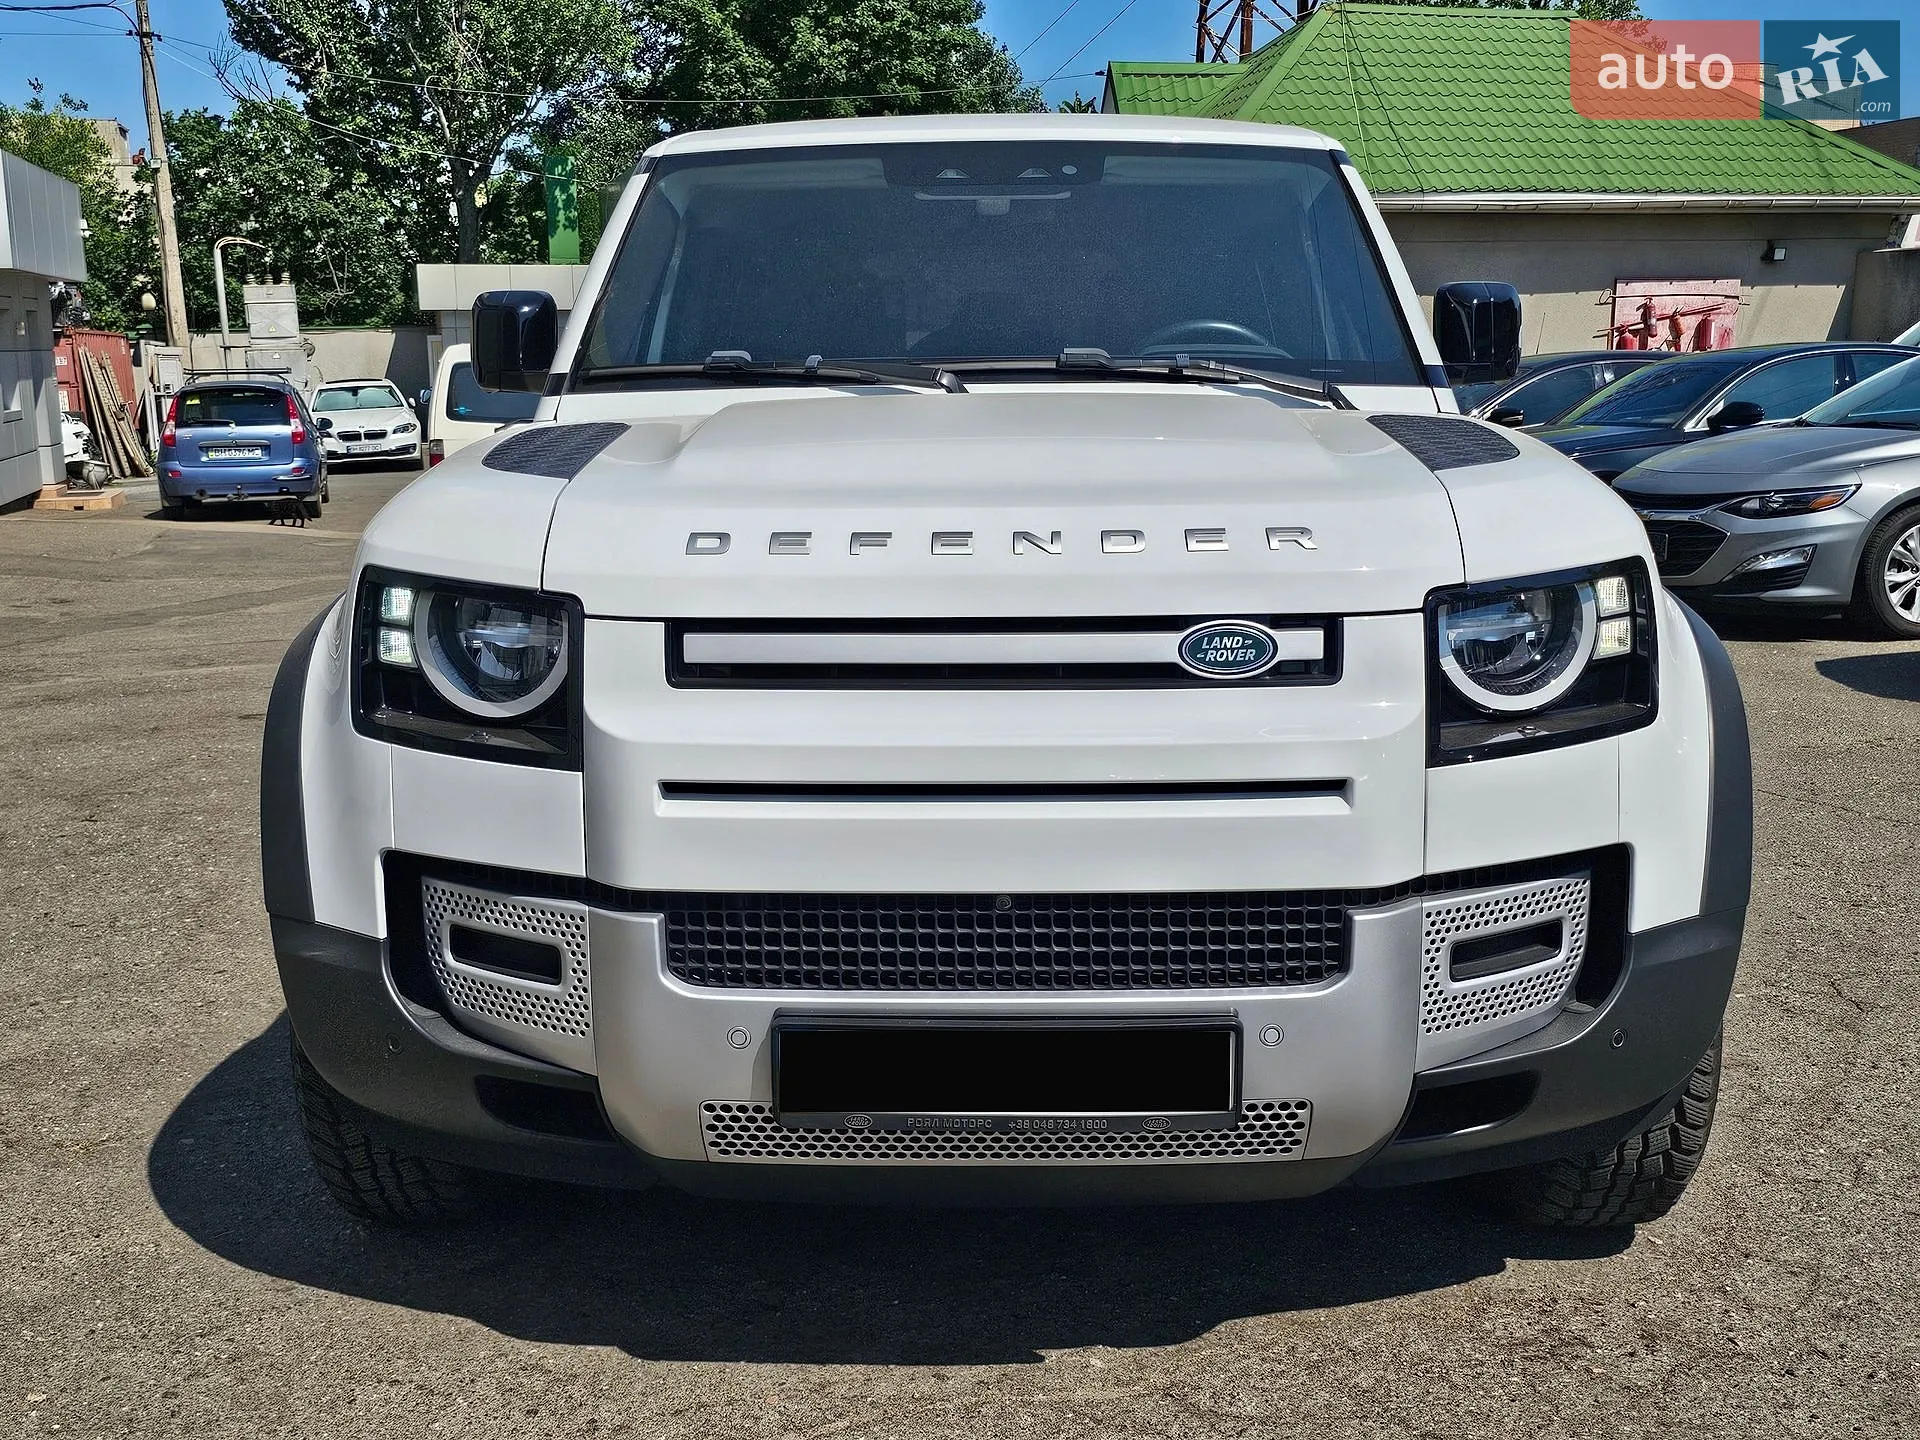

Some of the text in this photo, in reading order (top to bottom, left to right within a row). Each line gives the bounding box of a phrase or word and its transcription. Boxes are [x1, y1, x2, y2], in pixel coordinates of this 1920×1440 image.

[685, 526, 1319, 556] DEFENDER
[907, 1117, 939, 1128] РОЯЛ
[943, 1118, 992, 1129] МОТОРС
[1008, 1120, 1030, 1130] +38
[1056, 1119, 1077, 1129] 734
